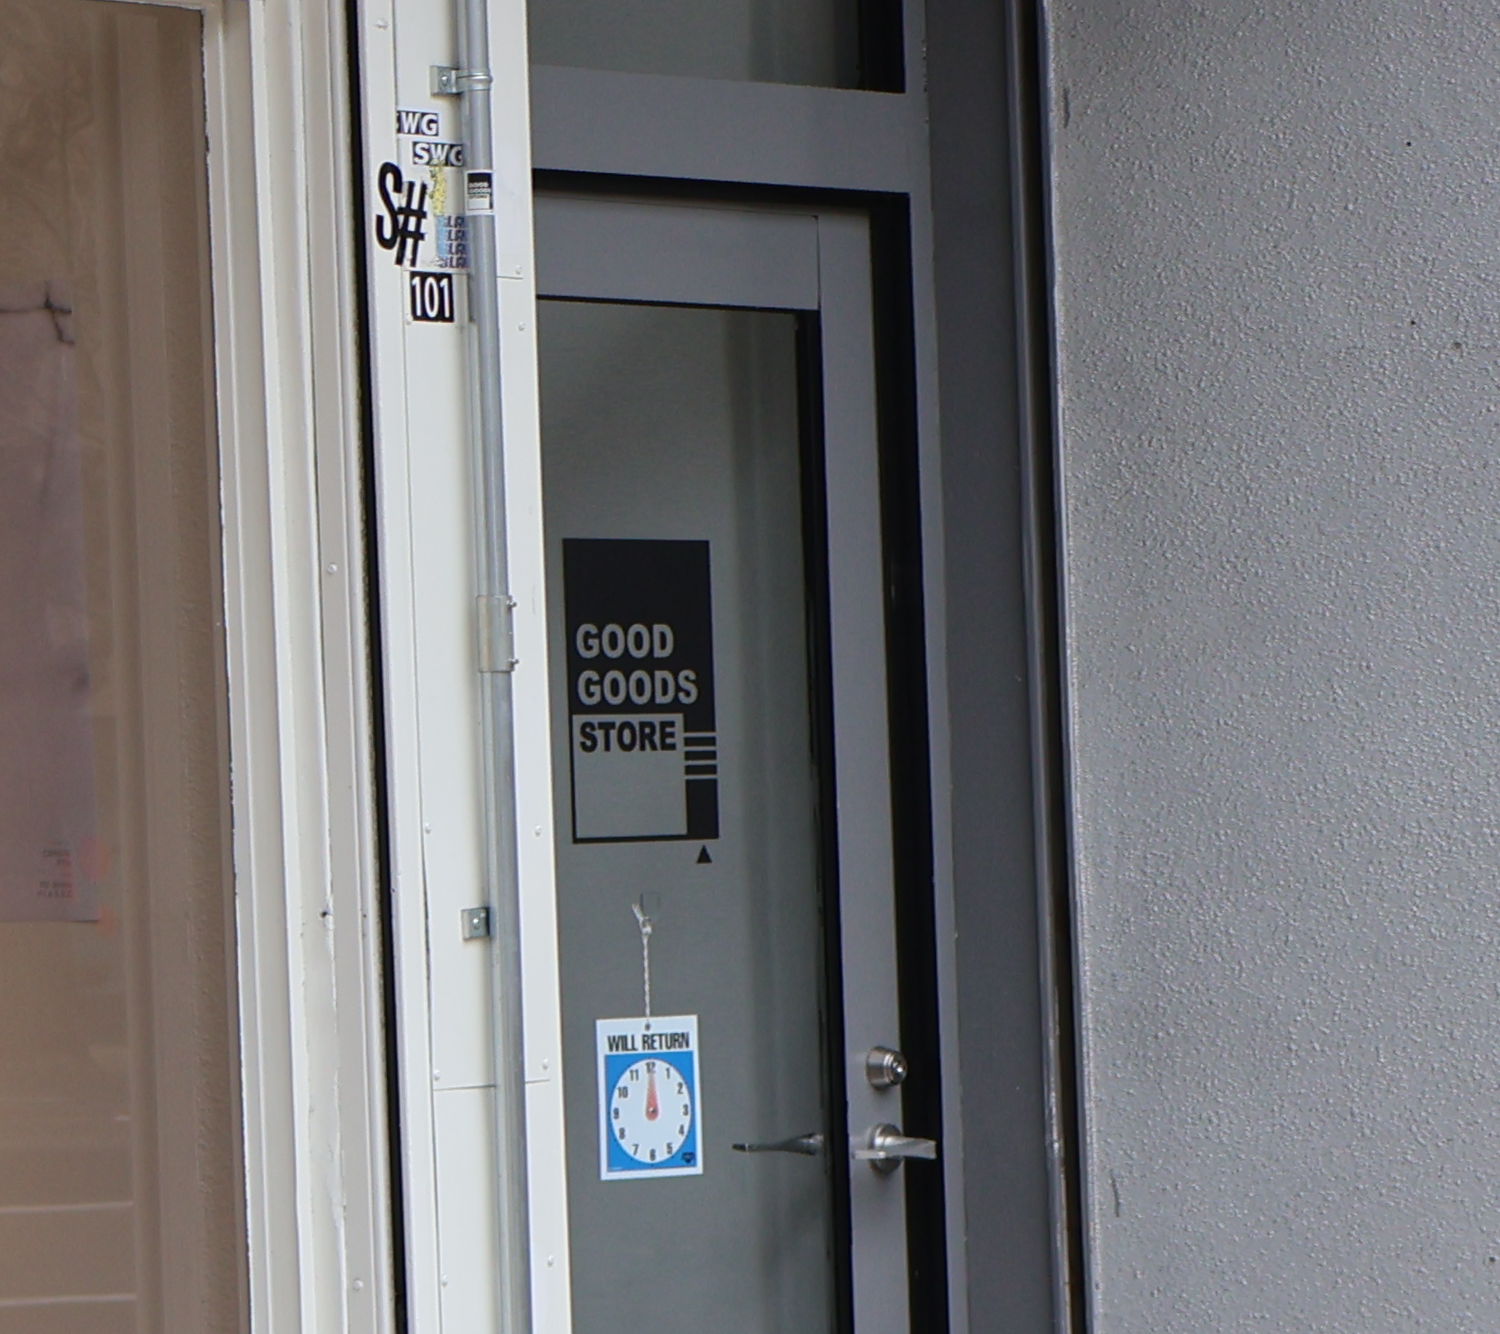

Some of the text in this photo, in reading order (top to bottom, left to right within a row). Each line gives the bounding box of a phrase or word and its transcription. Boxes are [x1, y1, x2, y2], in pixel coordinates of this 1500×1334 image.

[396, 112, 438, 135] WG
[414, 143, 464, 166] SWG
[411, 275, 450, 318] 101
[576, 623, 674, 659] GOOD
[577, 669, 699, 706] GOODS
[579, 720, 677, 753] STORE
[607, 1031, 690, 1052] WILL RETURN
[645, 1062, 656, 1074] 12
[665, 1068, 671, 1079] 1
[629, 1069, 639, 1081] 11
[617, 1086, 628, 1099] 10
[677, 1082, 684, 1095] 2
[613, 1108, 620, 1120] 9
[682, 1104, 689, 1116] 3
[619, 1128, 626, 1140] 8
[678, 1124, 685, 1136] 4
[632, 1144, 639, 1155] 7
[650, 1149, 656, 1161] 6
[666, 1143, 673, 1155] 5
